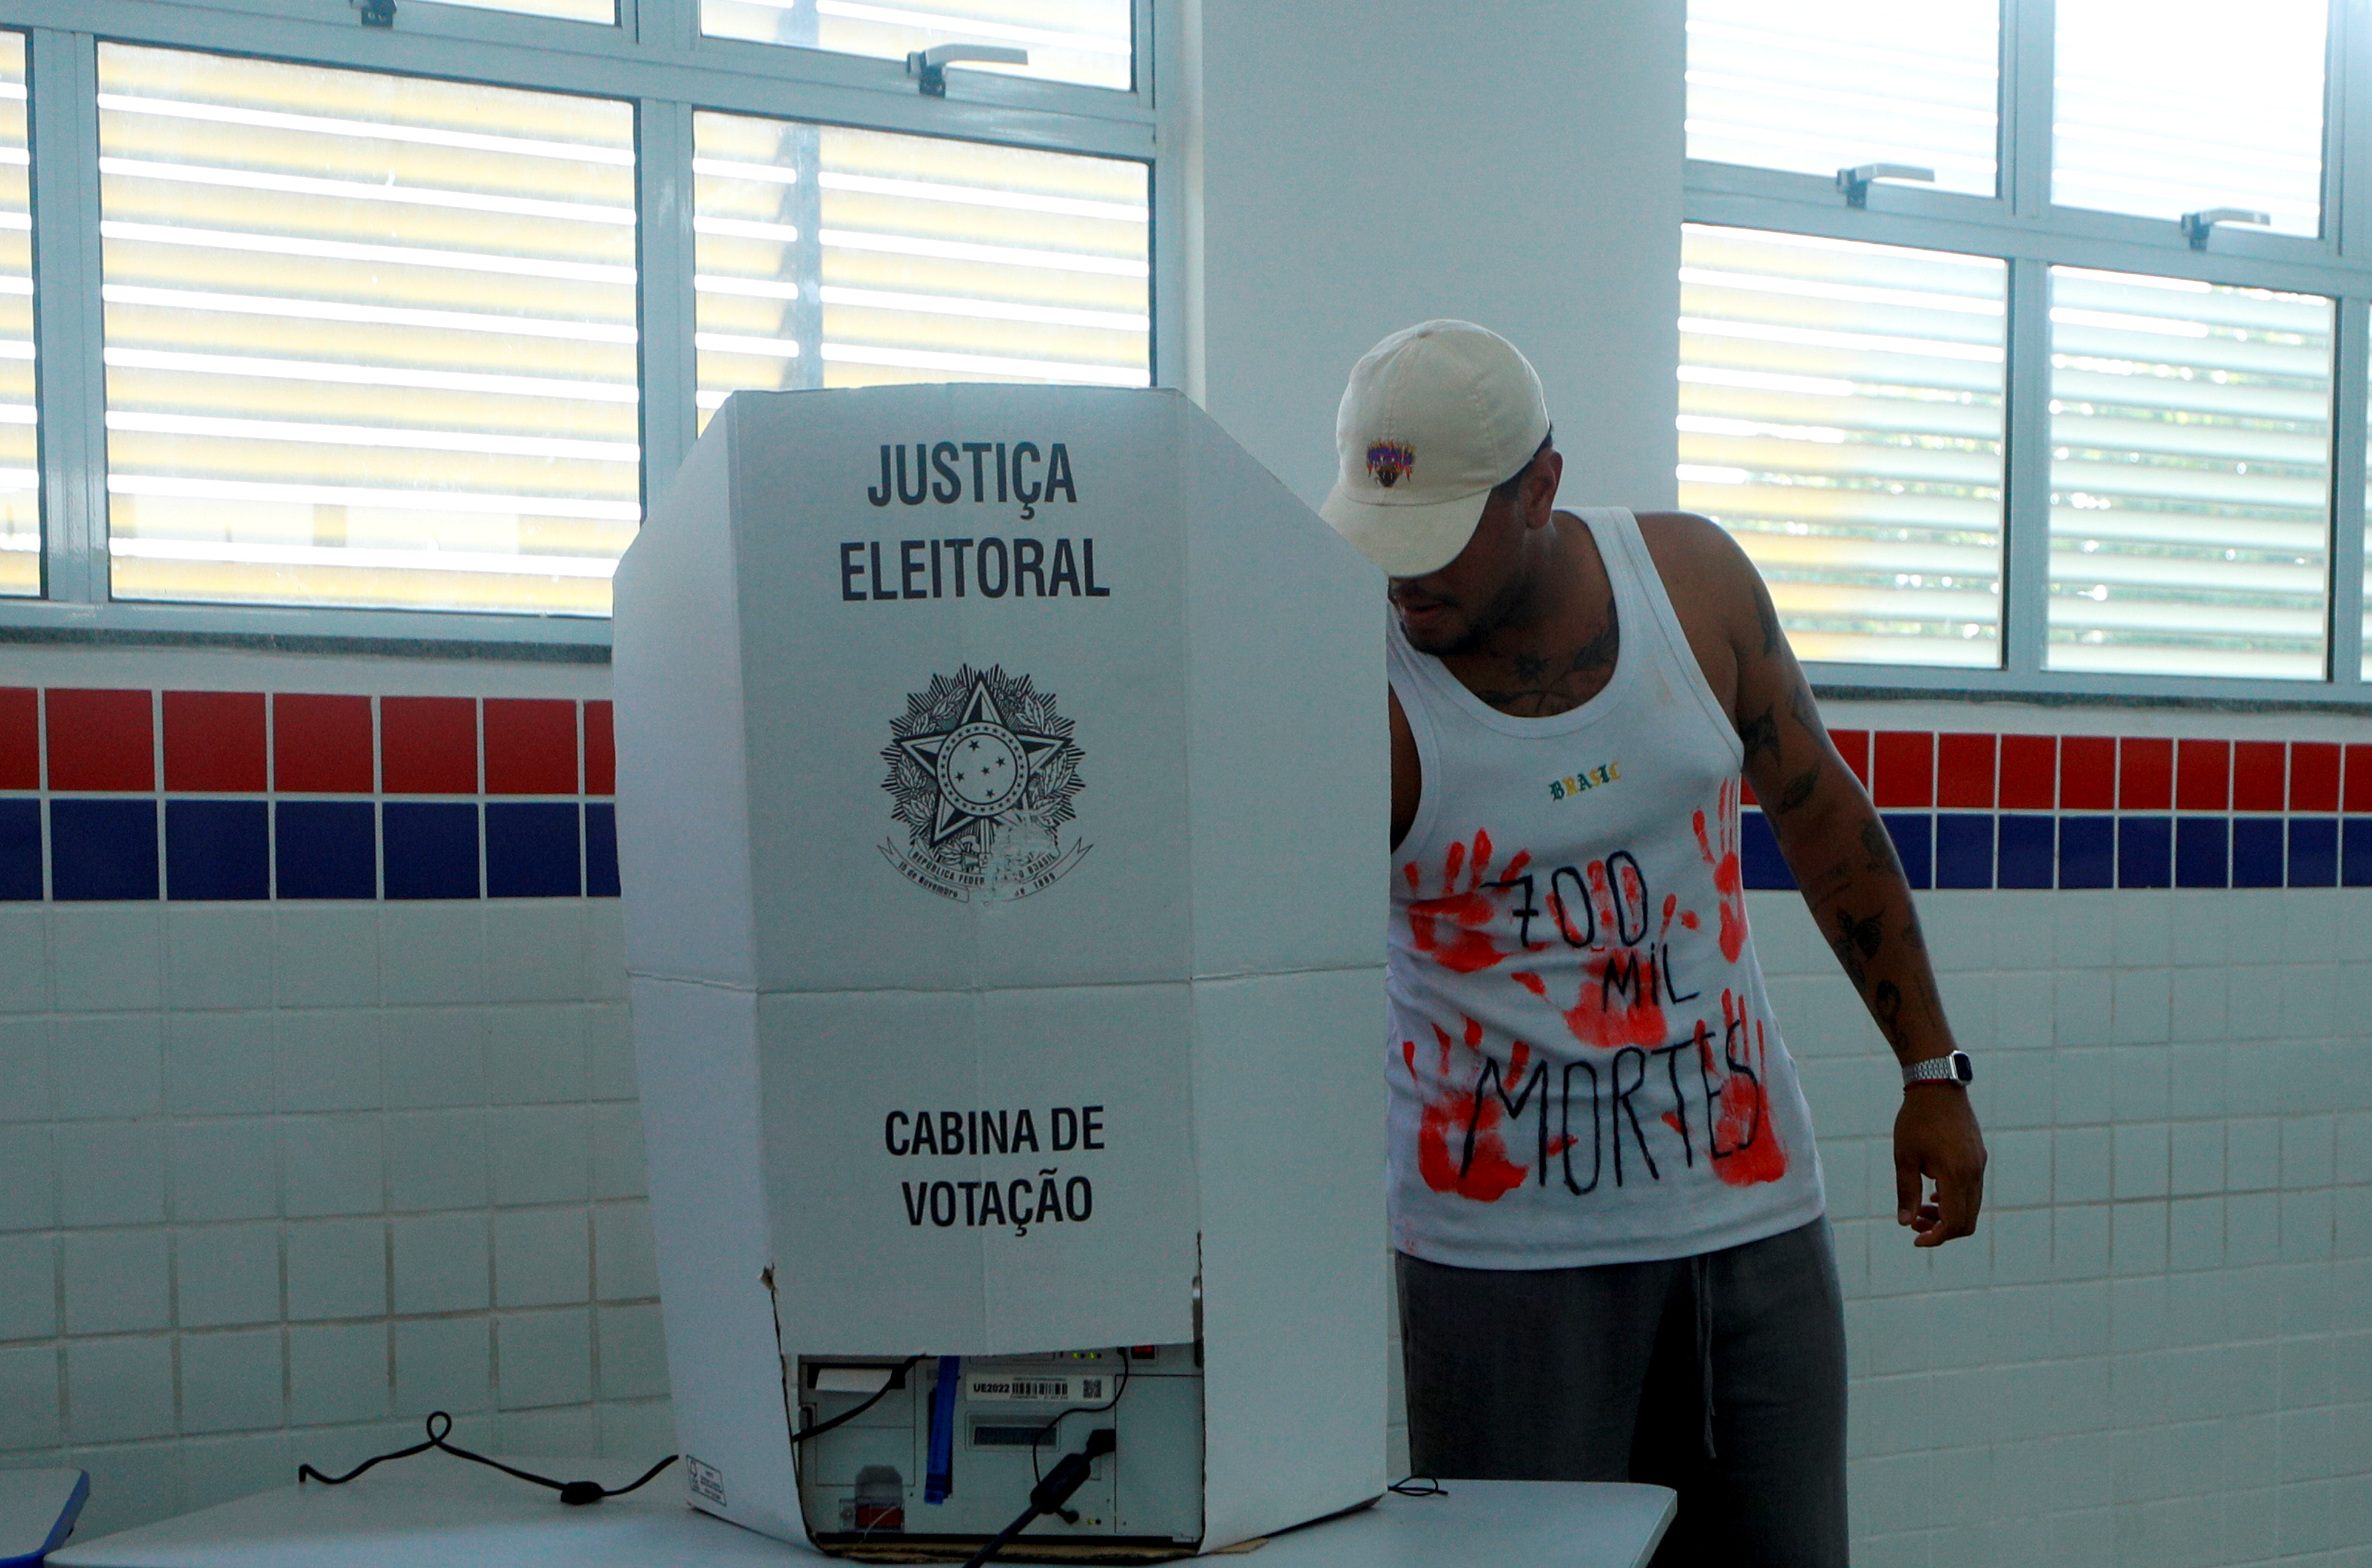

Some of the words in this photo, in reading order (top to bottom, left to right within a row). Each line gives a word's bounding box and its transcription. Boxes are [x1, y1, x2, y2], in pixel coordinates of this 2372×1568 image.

[868, 441, 1077, 520] JUSTIÇA
[840, 537, 1111, 601] ELEITORAL
[1548, 761, 1622, 801] BRASIL
[1480, 850, 1648, 949] 700
[885, 1109, 1040, 1156] CABINA
[1051, 1105, 1105, 1151] DE
[1460, 1019, 1760, 1196] MORTES
[901, 1167, 1093, 1237] VOTAÇÃO
[973, 1383, 1010, 1393] UE2022
